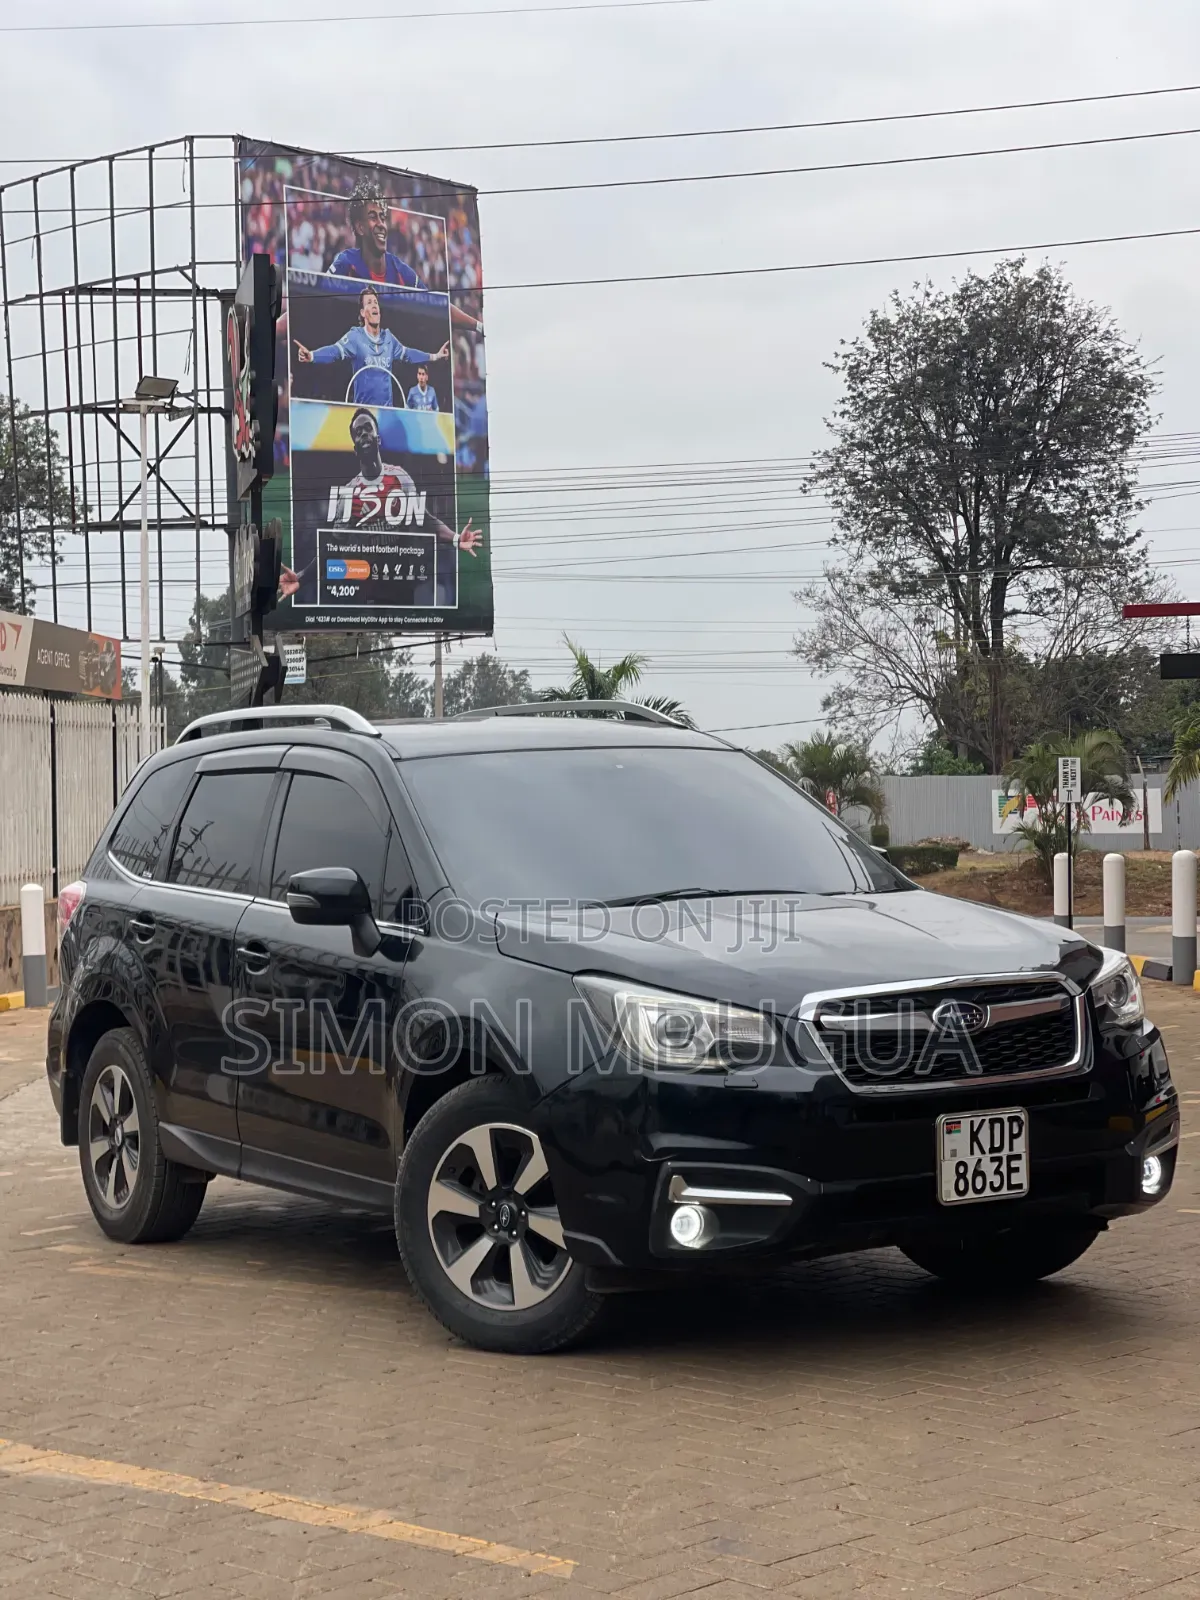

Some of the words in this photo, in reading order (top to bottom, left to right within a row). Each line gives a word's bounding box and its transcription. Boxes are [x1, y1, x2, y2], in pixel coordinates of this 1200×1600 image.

[327, 484, 384, 527] IT'S
[385, 489, 427, 527] ON
[326, 543, 338, 552] The
[339, 543, 361, 552] world's
[361, 544, 375, 553] best
[375, 545, 398, 554] football
[399, 547, 425, 557] package
[331, 585, 355, 597] 4,200
[305, 615, 315, 623] Dial
[337, 615, 360, 623] Download
[378, 615, 388, 624] App
[394, 616, 403, 624] stay
[37, 648, 53, 665] AGENT
[54, 651, 70, 668] OFFICE
[969, 1115, 1025, 1155] KDP
[954, 1153, 1023, 1197] 863E
